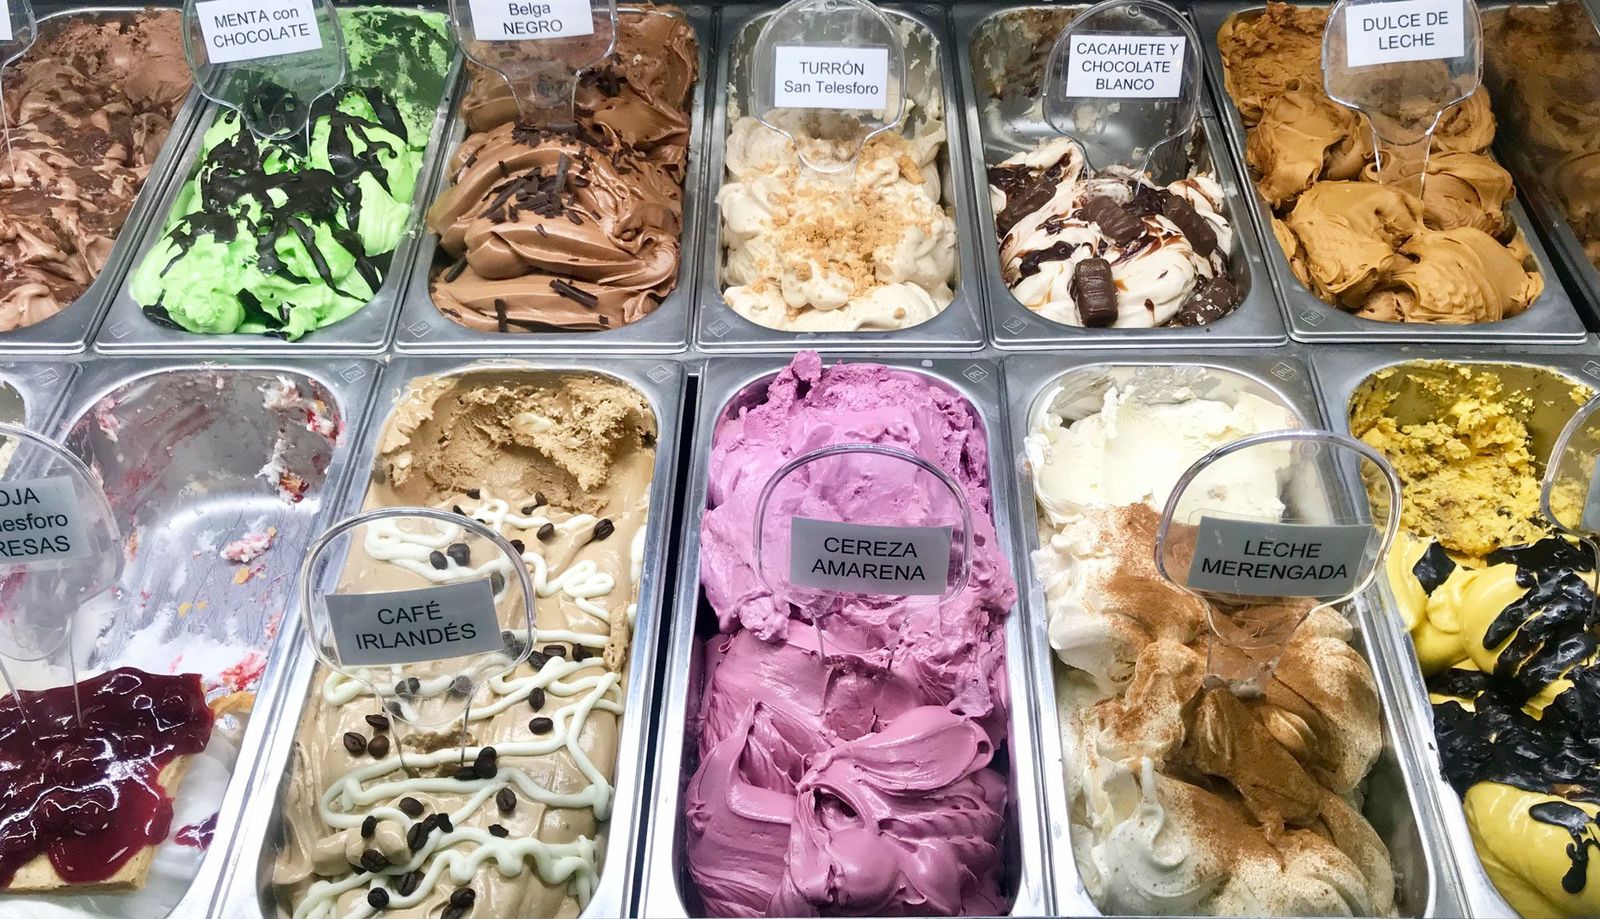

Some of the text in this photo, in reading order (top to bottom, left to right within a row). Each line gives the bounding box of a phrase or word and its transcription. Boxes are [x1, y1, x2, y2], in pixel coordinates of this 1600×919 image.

[215, 9, 299, 28] MENTA con
[509, 3, 550, 17] Belga
[504, 20, 562, 34] NEGRO
[1363, 11, 1448, 32] DULCE DE
[213, 22, 311, 48] CHOCOLATE
[1379, 32, 1434, 49] LECHE
[1077, 43, 1179, 55] CACAHUETE Y
[800, 60, 864, 75] TURRÓN
[1082, 61, 1170, 72] CHOCOLATE
[785, 80, 878, 95] San Telesforo
[1096, 79, 1154, 90] BLANCO
[824, 537, 917, 557] CEREZA
[1244, 540, 1322, 558] LECHE
[812, 559, 925, 580] AMARENA
[1202, 558, 1346, 579] MERENGADA
[378, 601, 443, 624] CAFÉ
[355, 621, 477, 650] IRLANDÉS
